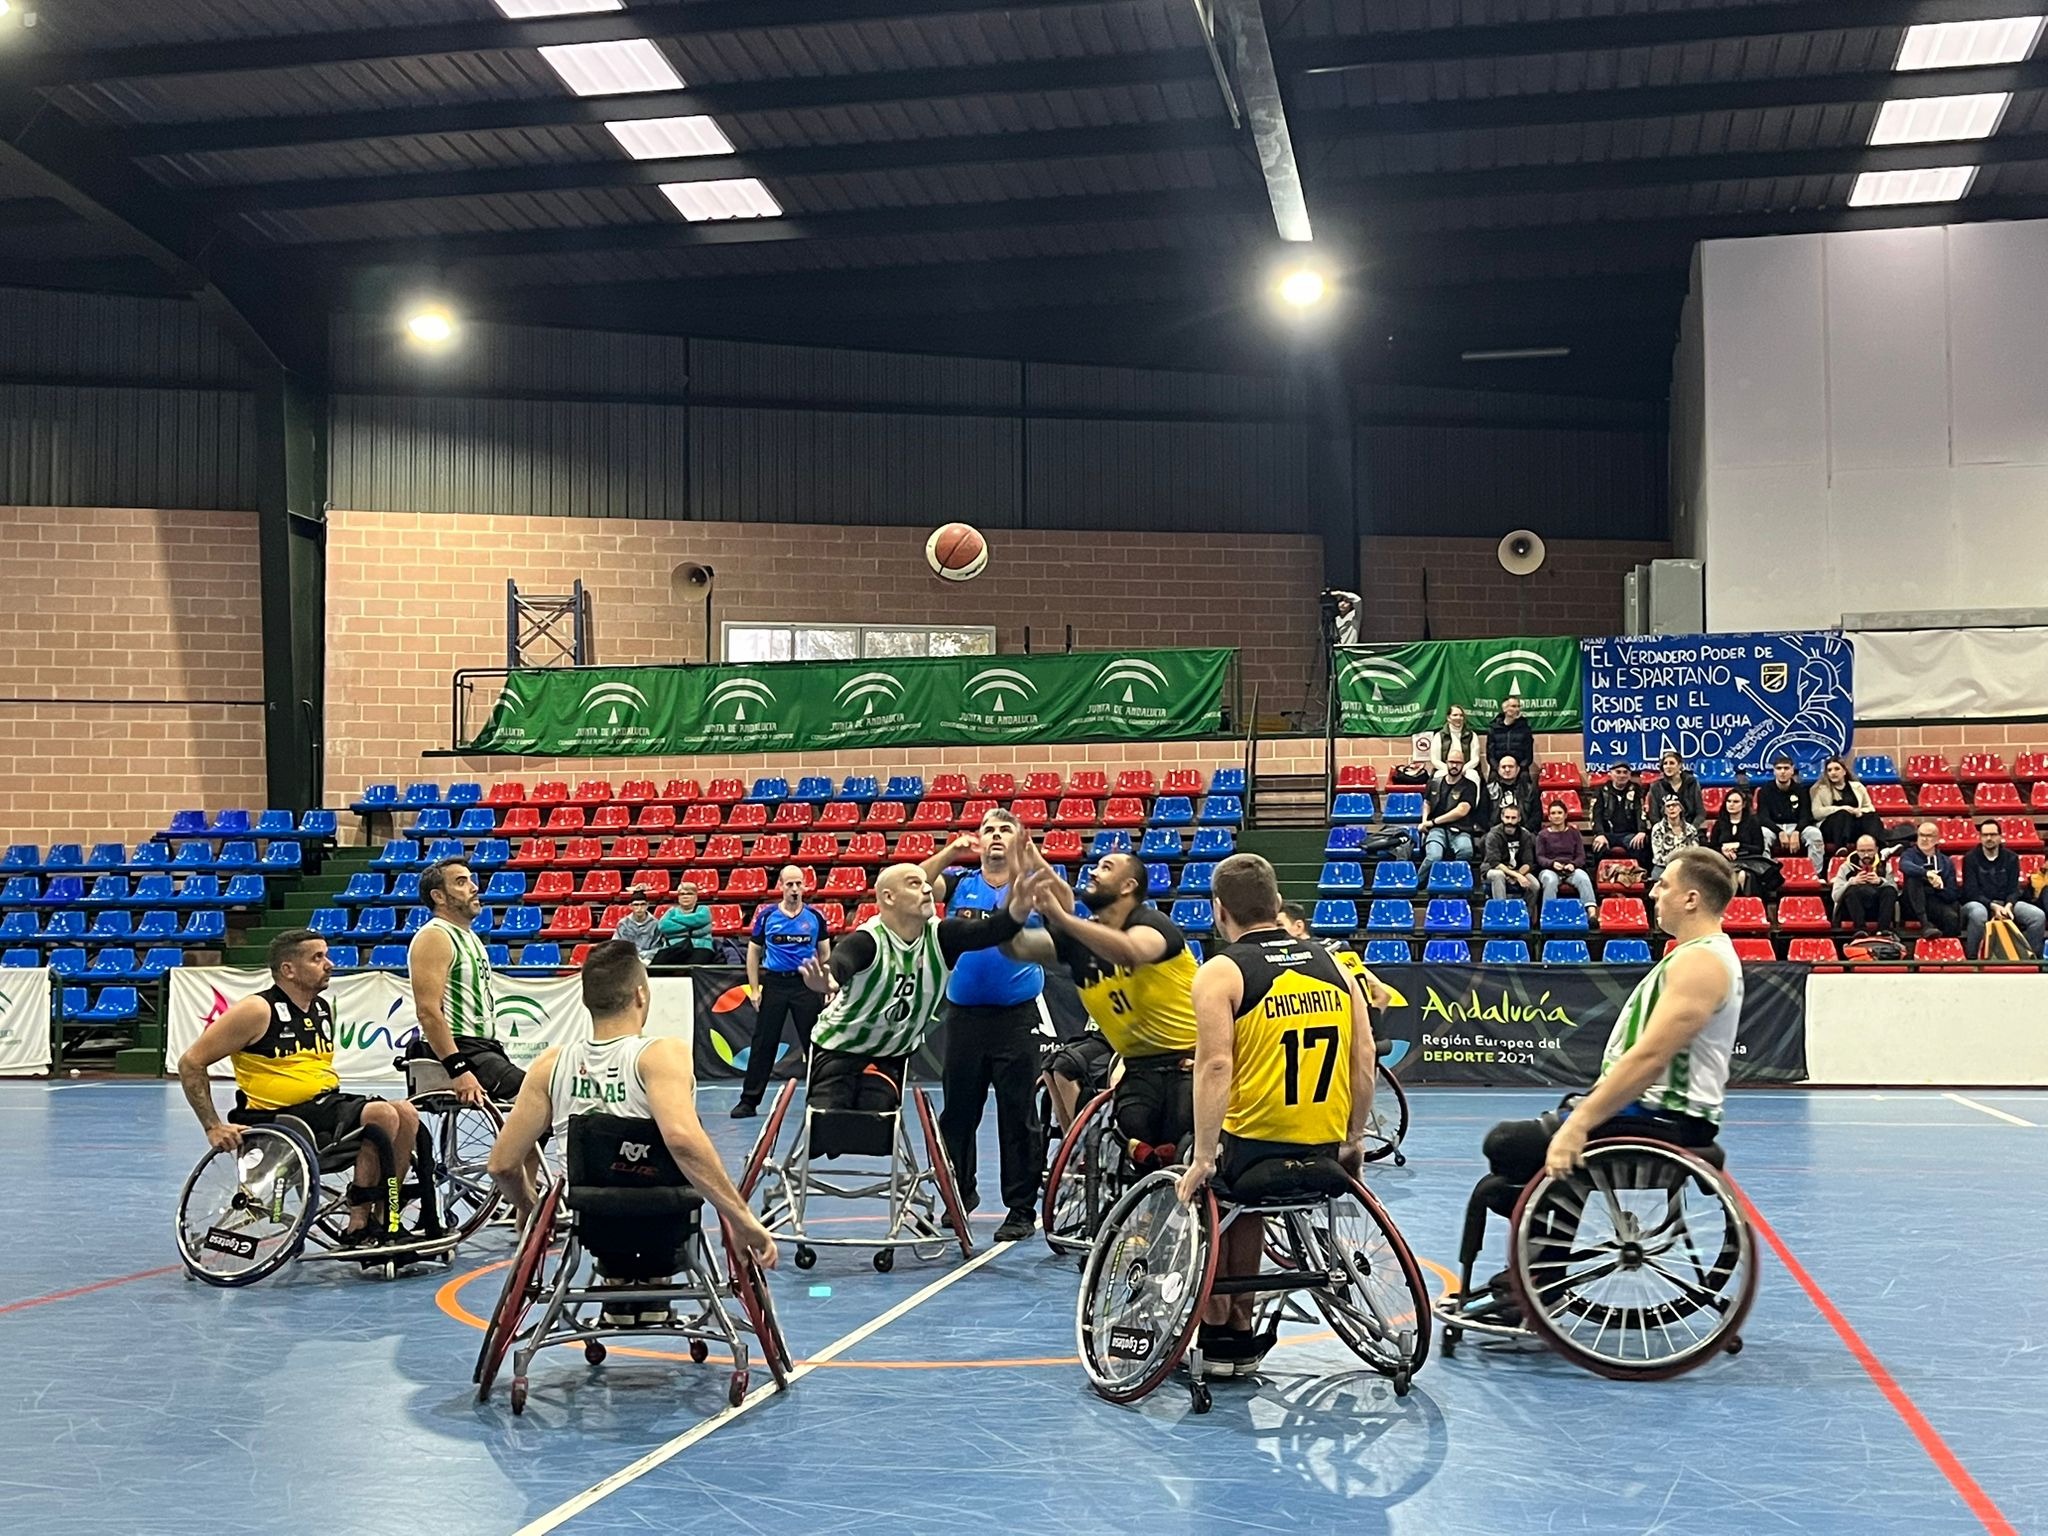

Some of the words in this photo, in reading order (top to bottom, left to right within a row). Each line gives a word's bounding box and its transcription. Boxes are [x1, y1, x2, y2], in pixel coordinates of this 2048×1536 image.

[1617, 644, 1697, 666] VERDADERO
[1701, 645, 1746, 661] PODER
[1754, 646, 1774, 659] DE
[1592, 671, 1610, 689] UN
[1616, 665, 1731, 689] ESPARTANO
[1087, 703, 1110, 714] JUNTA
[1473, 698, 1499, 709] JUNTA
[1520, 698, 1557, 709] NDALUCIA
[1592, 693, 1644, 714] RESIDE
[1656, 693, 1678, 711] EN
[1688, 690, 1711, 708] EL
[728, 724, 737, 733] DE
[985, 715, 994, 725] DE
[1590, 714, 1670, 734] COMPAÑERO
[1676, 714, 1704, 730] QUE
[1710, 713, 1752, 730] LUCHA
[1589, 741, 1603, 756] A
[1610, 739, 1628, 756] SU
[1109, 989, 1133, 1015] 31
[1264, 990, 1343, 1019] CHICHIRITA
[1421, 985, 1579, 1028] Andalucía
[1422, 1034, 1471, 1049] Región
[1475, 1035, 1534, 1050] Europea
[1538, 1037, 1561, 1049] del
[1279, 1025, 1339, 1106] 17
[1423, 1050, 1495, 1062] DEPORTE
[1498, 1052, 1535, 1065] 2021
